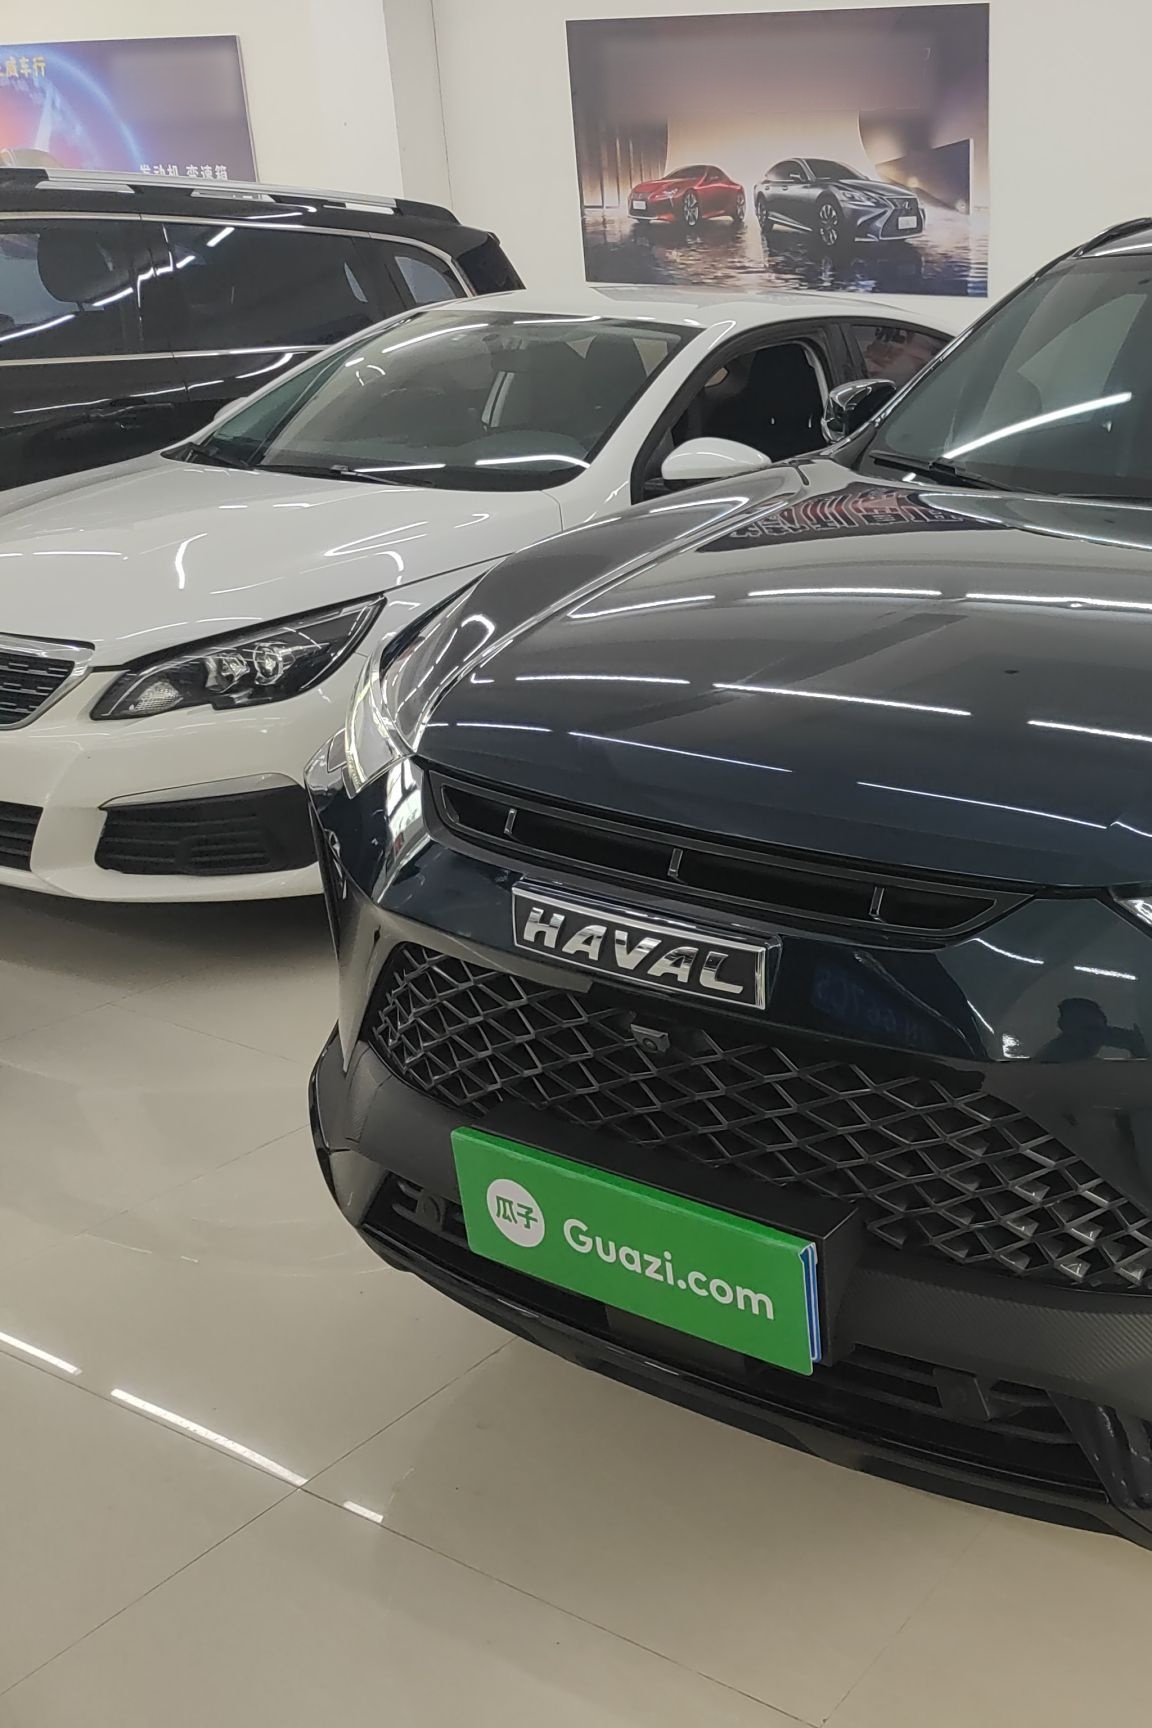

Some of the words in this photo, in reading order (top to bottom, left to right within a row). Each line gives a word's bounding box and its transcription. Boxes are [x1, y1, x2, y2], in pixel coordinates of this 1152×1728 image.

[140, 164, 179, 176] 发动机
[185, 164, 228, 180] 变速箱
[523, 907, 744, 994] HAVAL
[496, 1195, 538, 1229] 瓜子
[563, 1218, 775, 1321] Guazi.com
